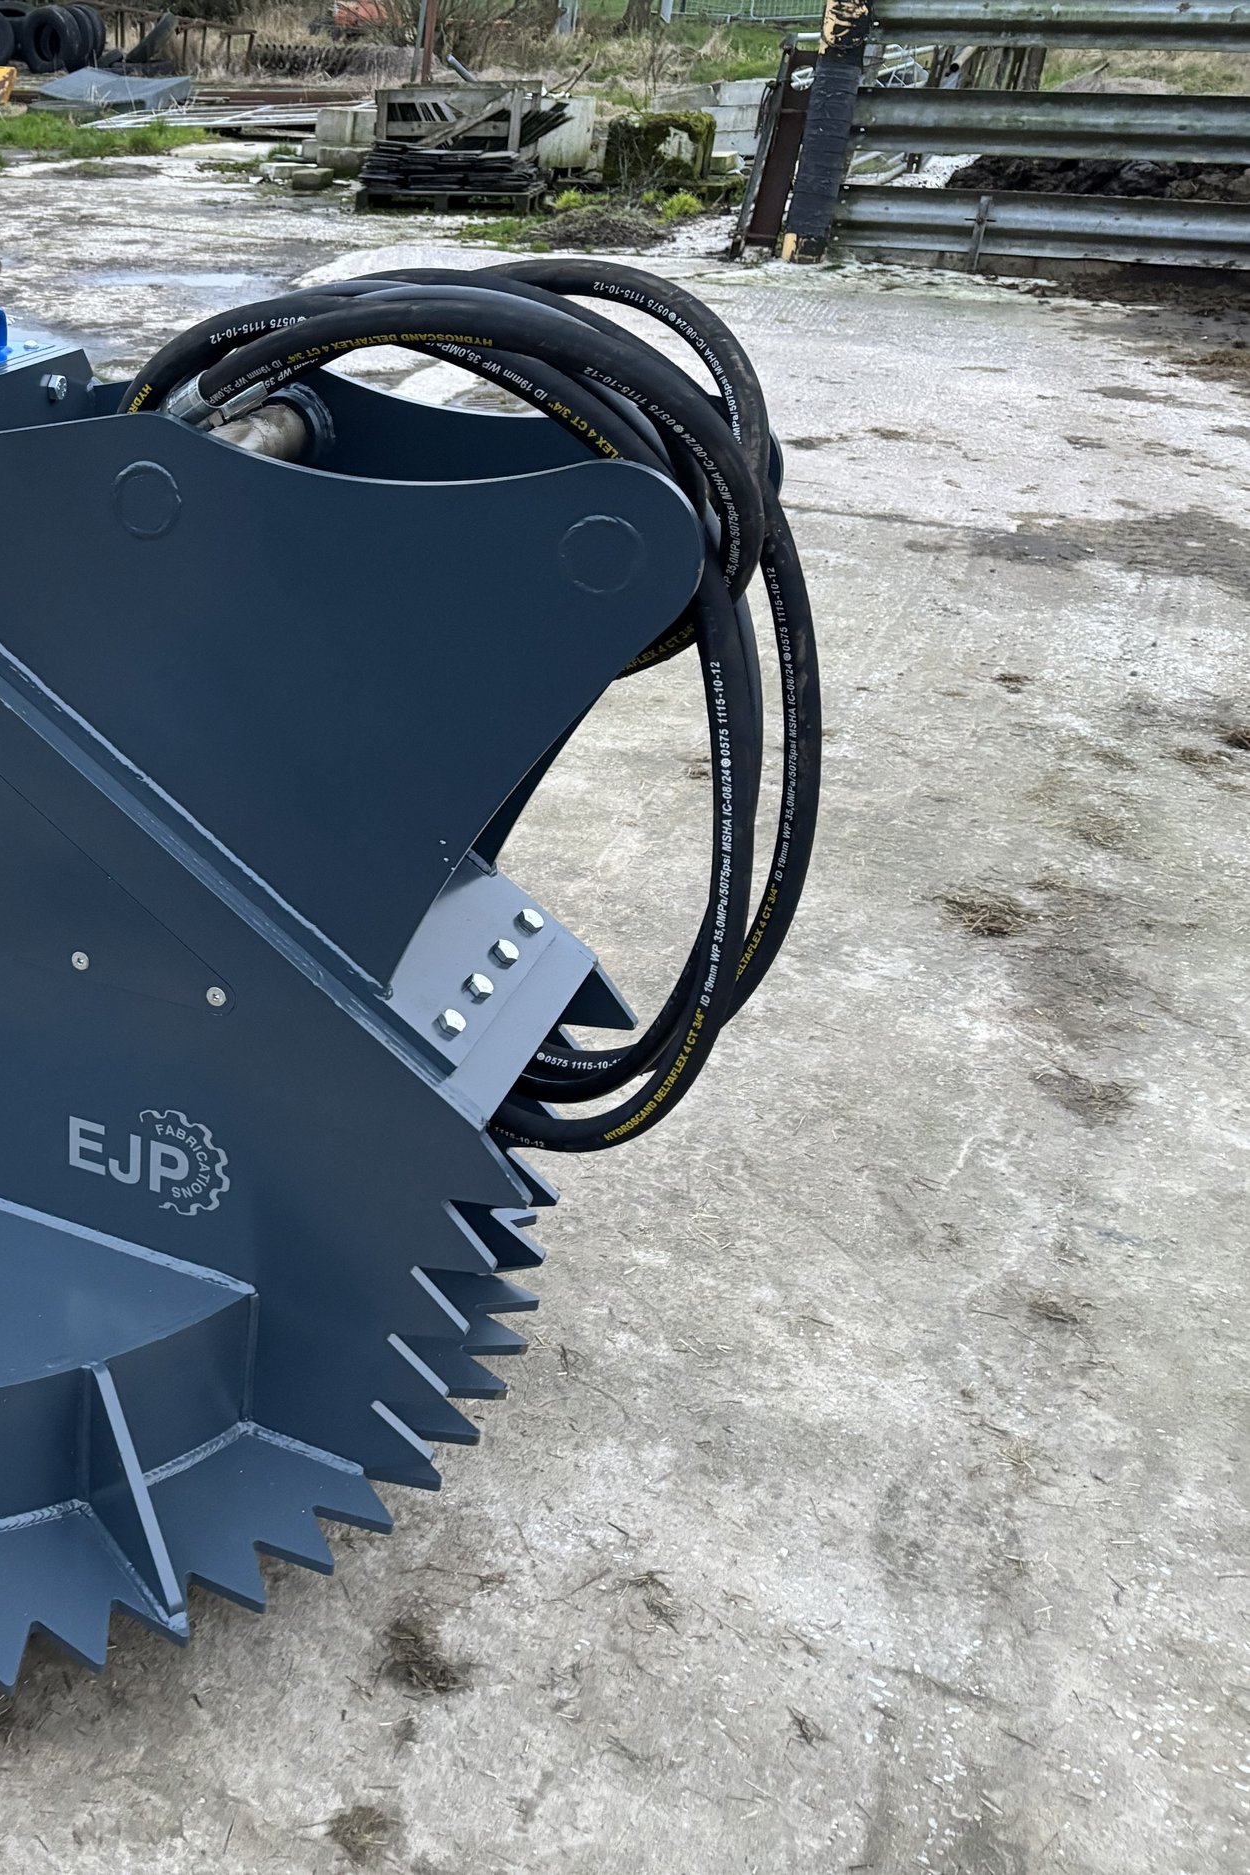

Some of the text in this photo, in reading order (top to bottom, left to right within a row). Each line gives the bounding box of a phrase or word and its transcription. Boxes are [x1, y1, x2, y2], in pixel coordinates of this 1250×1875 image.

[592, 281, 645, 304] 1115-10-12
[210, 320, 266, 344] 1115-10-12
[400, 333, 493, 346] HYDROSCAND
[330, 334, 398, 350] DELTAFLEX
[307, 346, 321, 358] CT
[704, 347, 724, 376] MSHA
[246, 364, 271, 380] 19mm
[272, 359, 283, 370] ID
[482, 360, 502, 374] WP
[233, 375, 249, 388] WP
[277, 368, 293, 382] WP
[502, 368, 534, 392] 19mm
[534, 388, 548, 401] ID
[583, 366, 647, 405] 1115-10-12
[570, 417, 588, 432] CT
[710, 472, 732, 500] MSHA
[766, 566, 786, 622] 1115-10-12
[666, 634, 680, 648] CT
[710, 660, 728, 724] 1115-10-12
[788, 708, 797, 738] MSHA
[719, 728, 730, 756] 0575
[722, 818, 733, 853] MSHA
[782, 822, 792, 840] WP
[777, 841, 790, 869] 19mm
[774, 870, 783, 882] ID
[762, 904, 773, 919] CT
[759, 920, 767, 928] 4
[710, 944, 722, 964] WP
[704, 964, 718, 993] 19mm
[700, 994, 711, 1007] ID
[686, 1030, 698, 1046] CT
[683, 1044, 692, 1054] 4
[654, 1051, 689, 1102] DELTAFLEX
[604, 1100, 658, 1141] HYDROSCAND
[69, 1115, 189, 1193] EJP
[155, 1124, 211, 1199] FABRICATIONS
